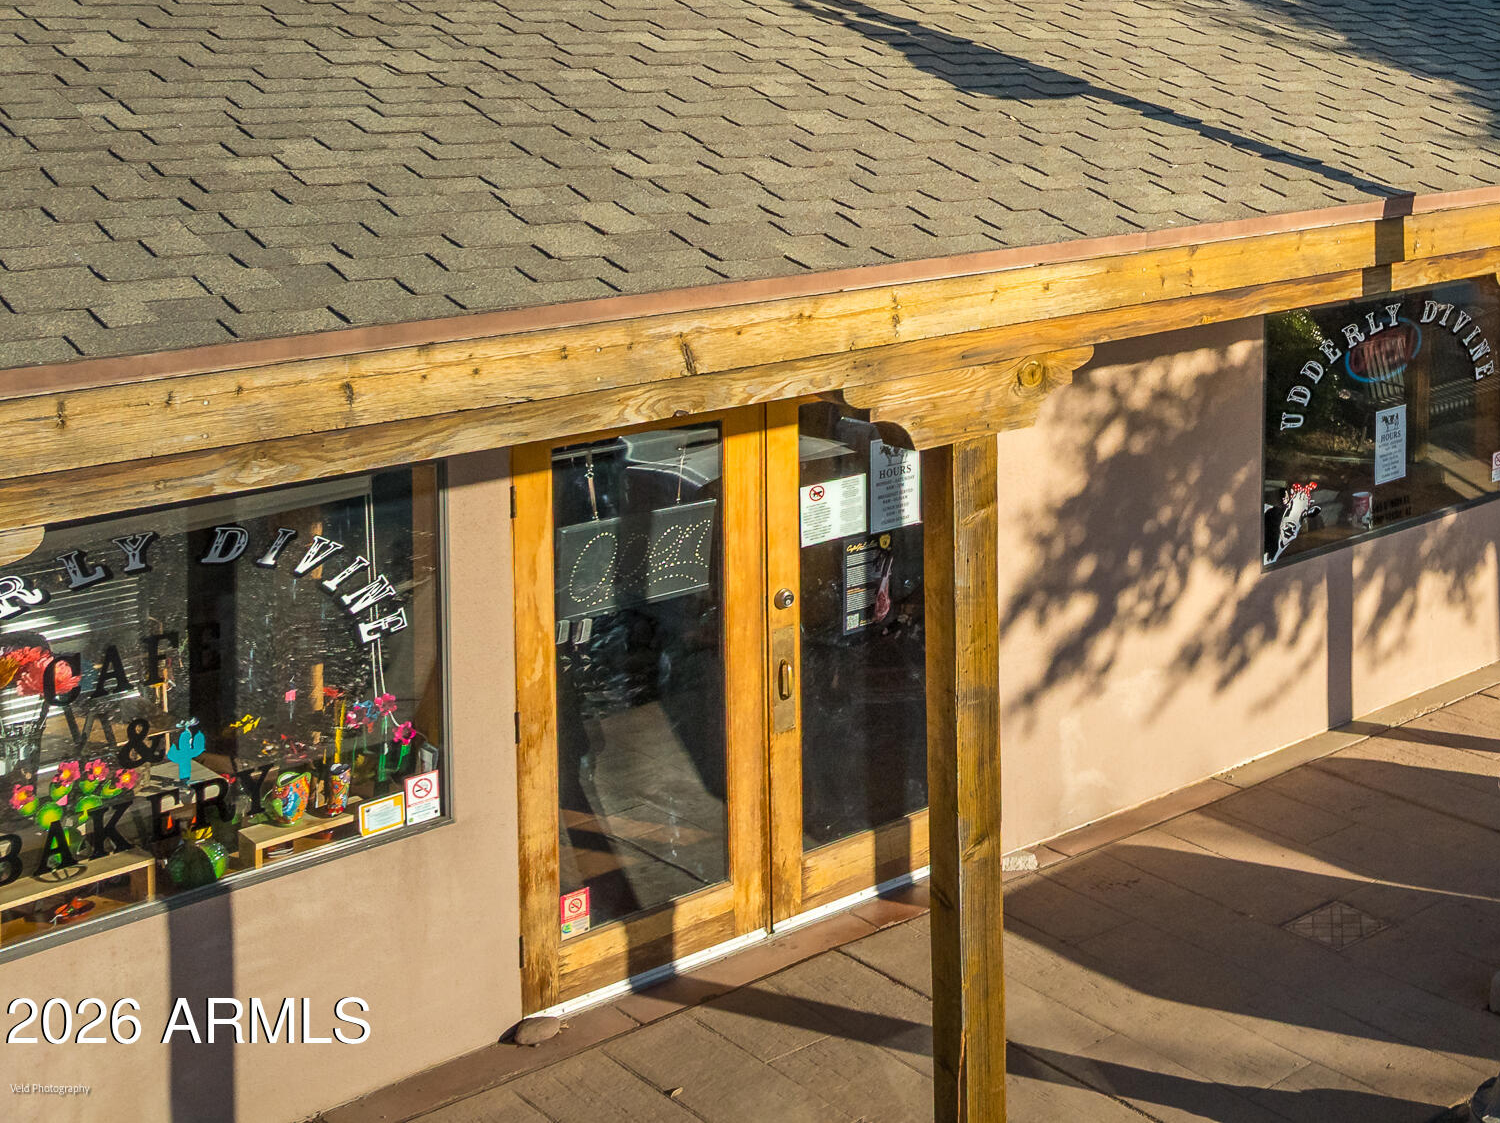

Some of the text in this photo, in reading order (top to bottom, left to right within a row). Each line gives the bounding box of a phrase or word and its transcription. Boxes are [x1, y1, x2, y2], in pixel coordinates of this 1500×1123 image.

[1280, 303, 1401, 431] UDDERLY
[1420, 300, 1495, 380] DIVINE
[879, 464, 912, 480] HOURS
[201, 526, 408, 644] DIVINE
[42, 622, 220, 707] CAF
[119, 718, 166, 768] &
